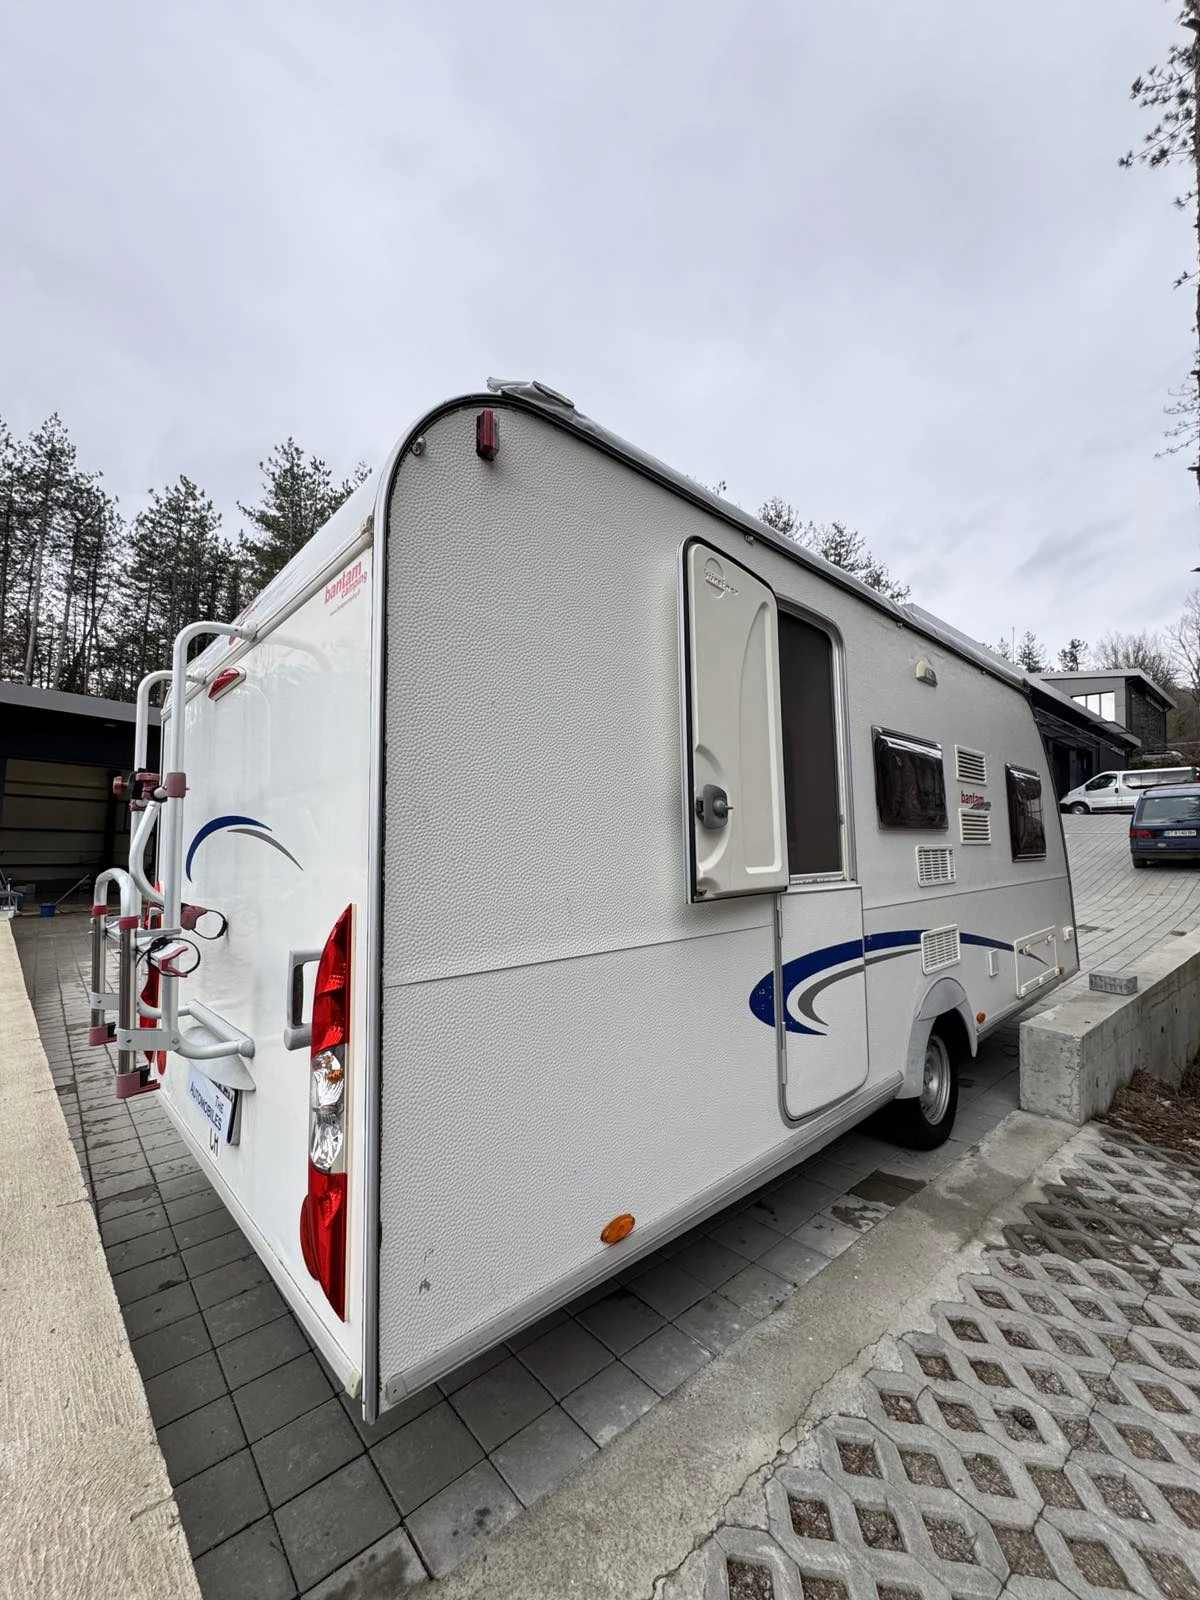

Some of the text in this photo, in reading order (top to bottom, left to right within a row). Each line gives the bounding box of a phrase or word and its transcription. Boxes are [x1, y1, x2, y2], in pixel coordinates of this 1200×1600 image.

[324, 560, 362, 605] bantam
[960, 789, 985, 805] bantam
[190, 1081, 223, 1132] AUTOMOBILES
